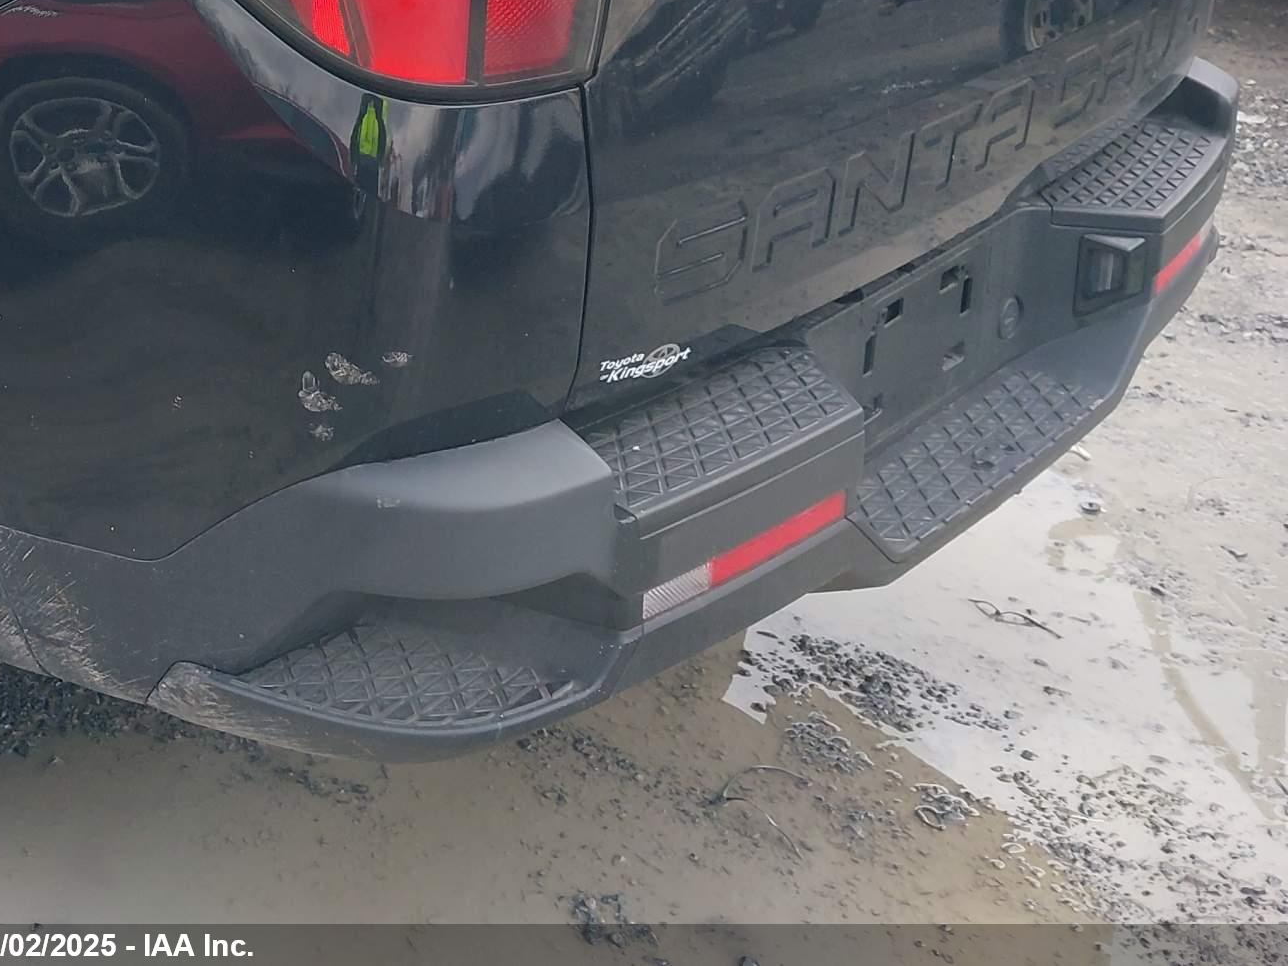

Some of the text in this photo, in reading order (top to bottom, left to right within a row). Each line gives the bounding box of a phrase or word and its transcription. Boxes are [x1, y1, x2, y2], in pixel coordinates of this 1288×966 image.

[654, 79, 1035, 305] SANTA
[600, 353, 645, 372] Toyota
[606, 346, 692, 384] Kingsport
